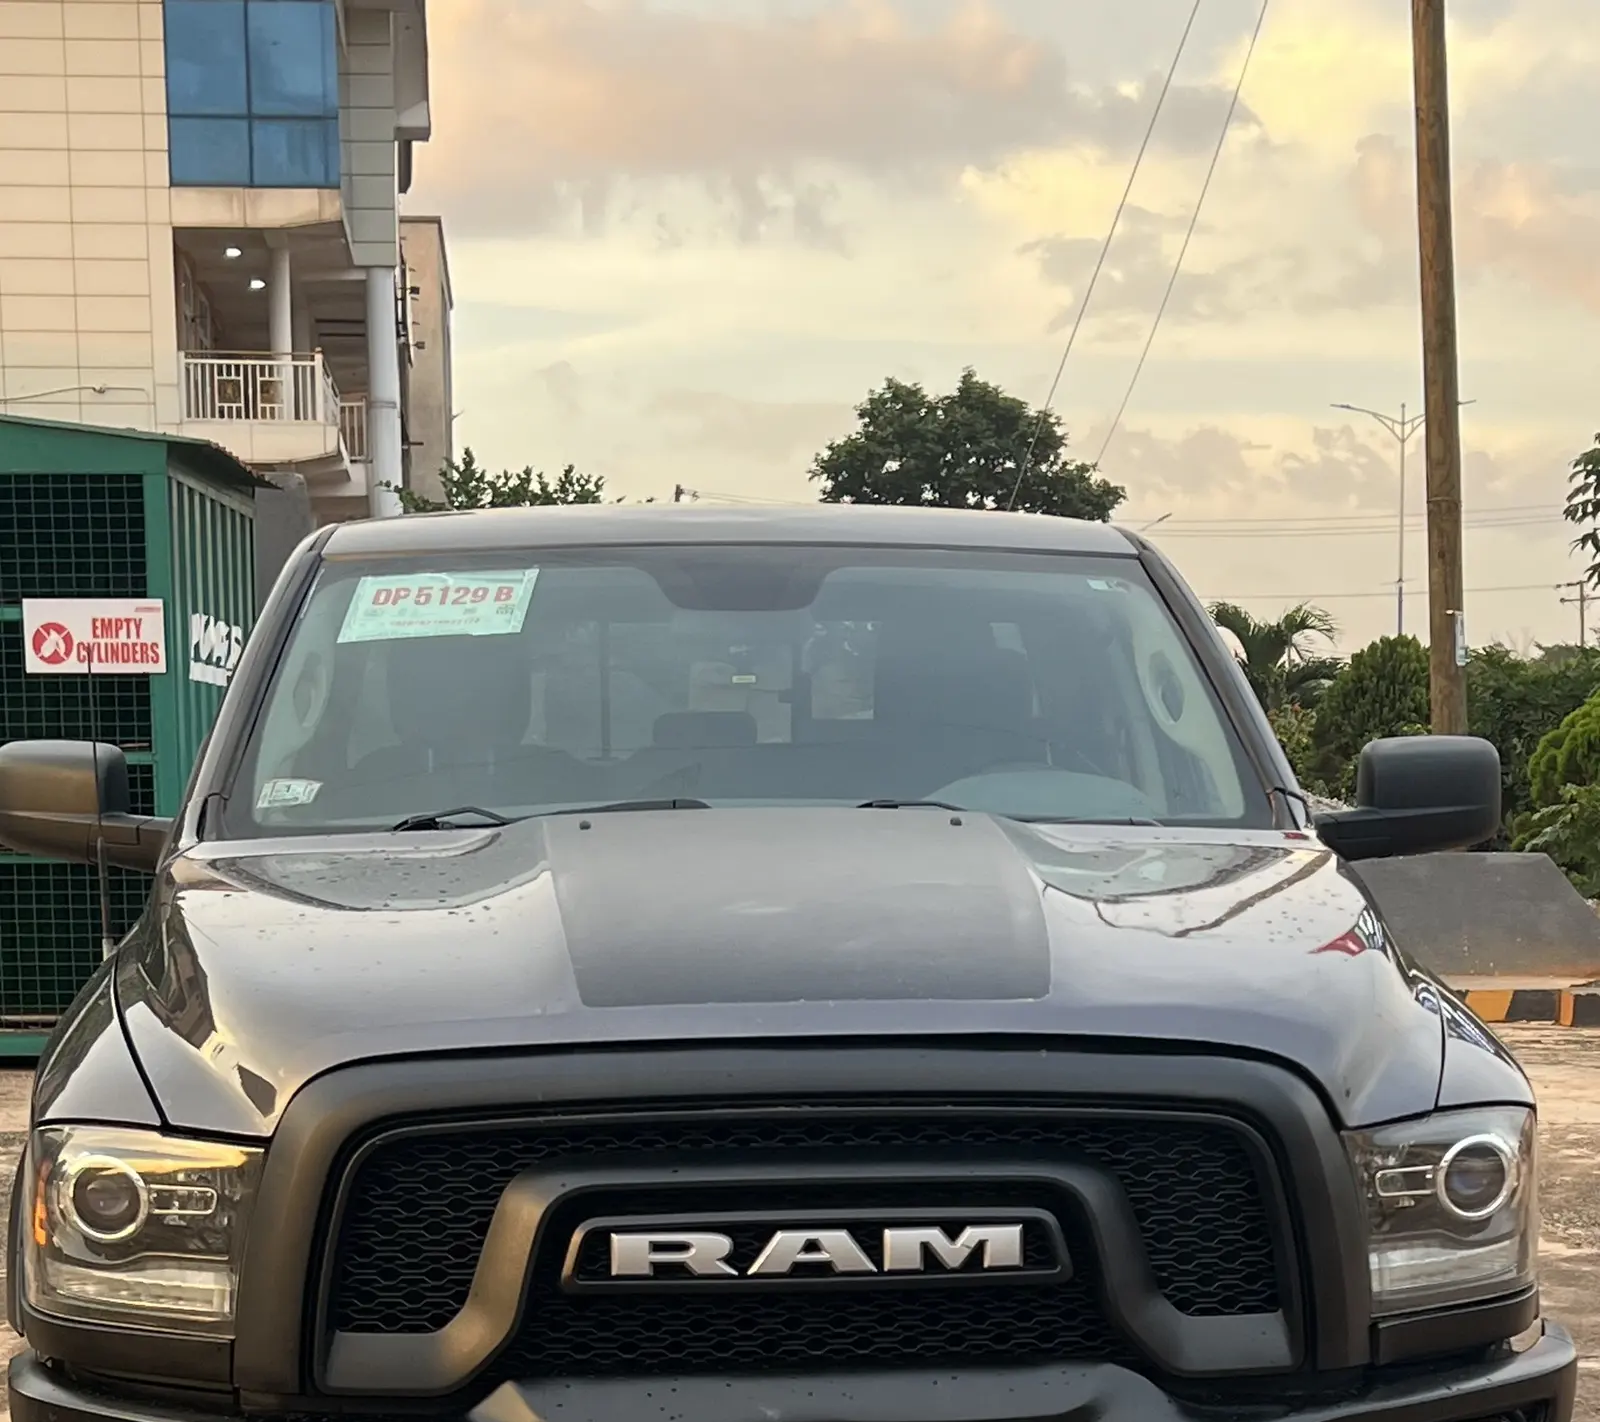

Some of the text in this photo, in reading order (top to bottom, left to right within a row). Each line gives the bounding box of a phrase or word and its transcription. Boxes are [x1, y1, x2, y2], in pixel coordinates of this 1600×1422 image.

[91, 617, 143, 639] EMPTY
[76, 641, 160, 664] CYLINDERS
[610, 1223, 1025, 1276] RAM
